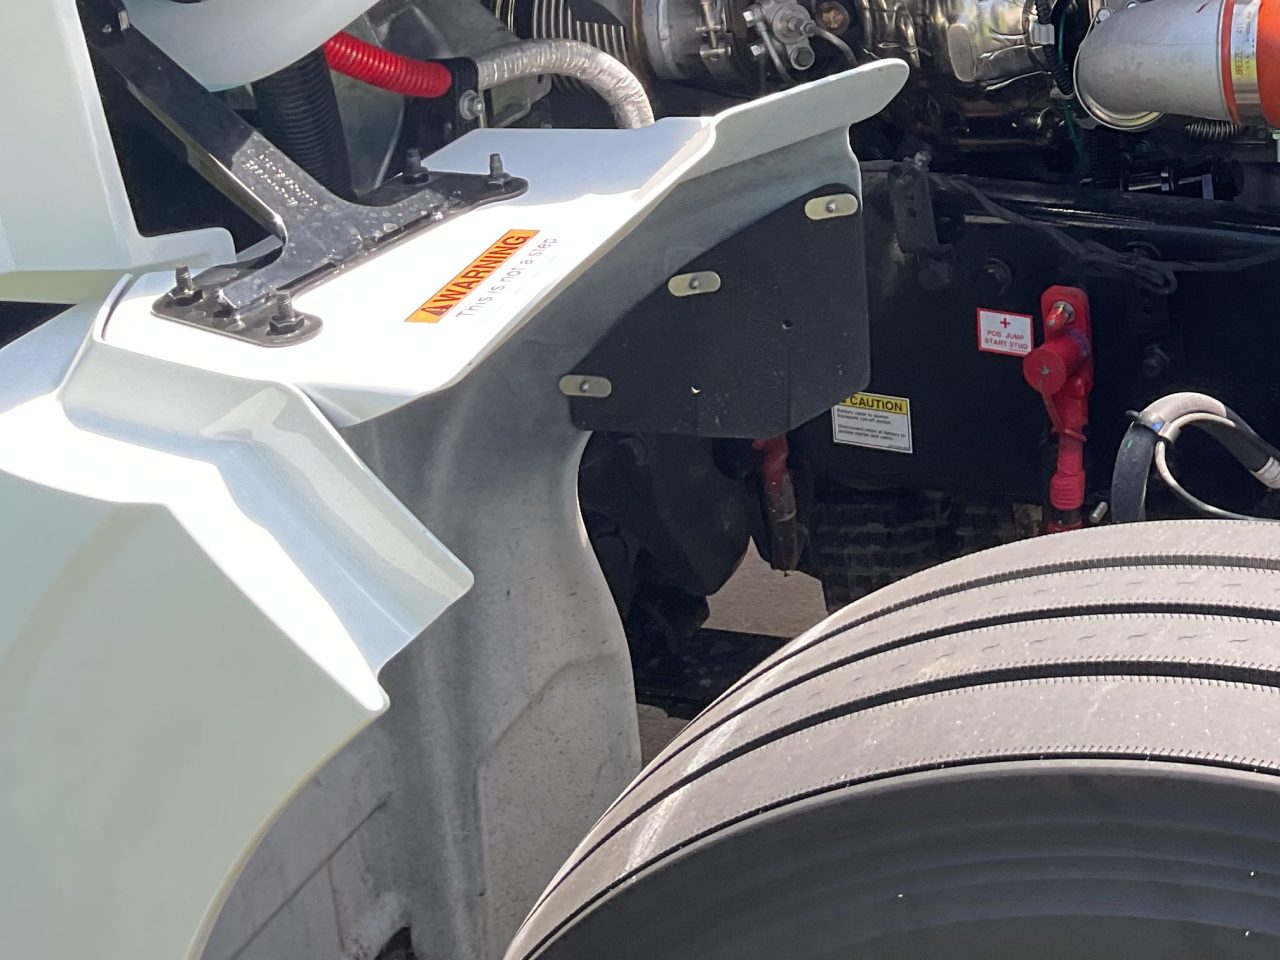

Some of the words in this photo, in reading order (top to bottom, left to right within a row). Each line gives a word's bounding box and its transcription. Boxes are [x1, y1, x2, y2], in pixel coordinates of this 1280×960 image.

[432, 235, 531, 304] WARNING
[456, 295, 493, 318] This
[488, 284, 505, 296] is
[500, 267, 526, 283] not
[520, 258, 533, 266] a
[988, 330, 1002, 338] POS
[1005, 332, 1024, 340] JUMP
[984, 338, 1008, 346] START
[1009, 341, 1028, 350] STUD
[850, 396, 902, 412] CAUTION
